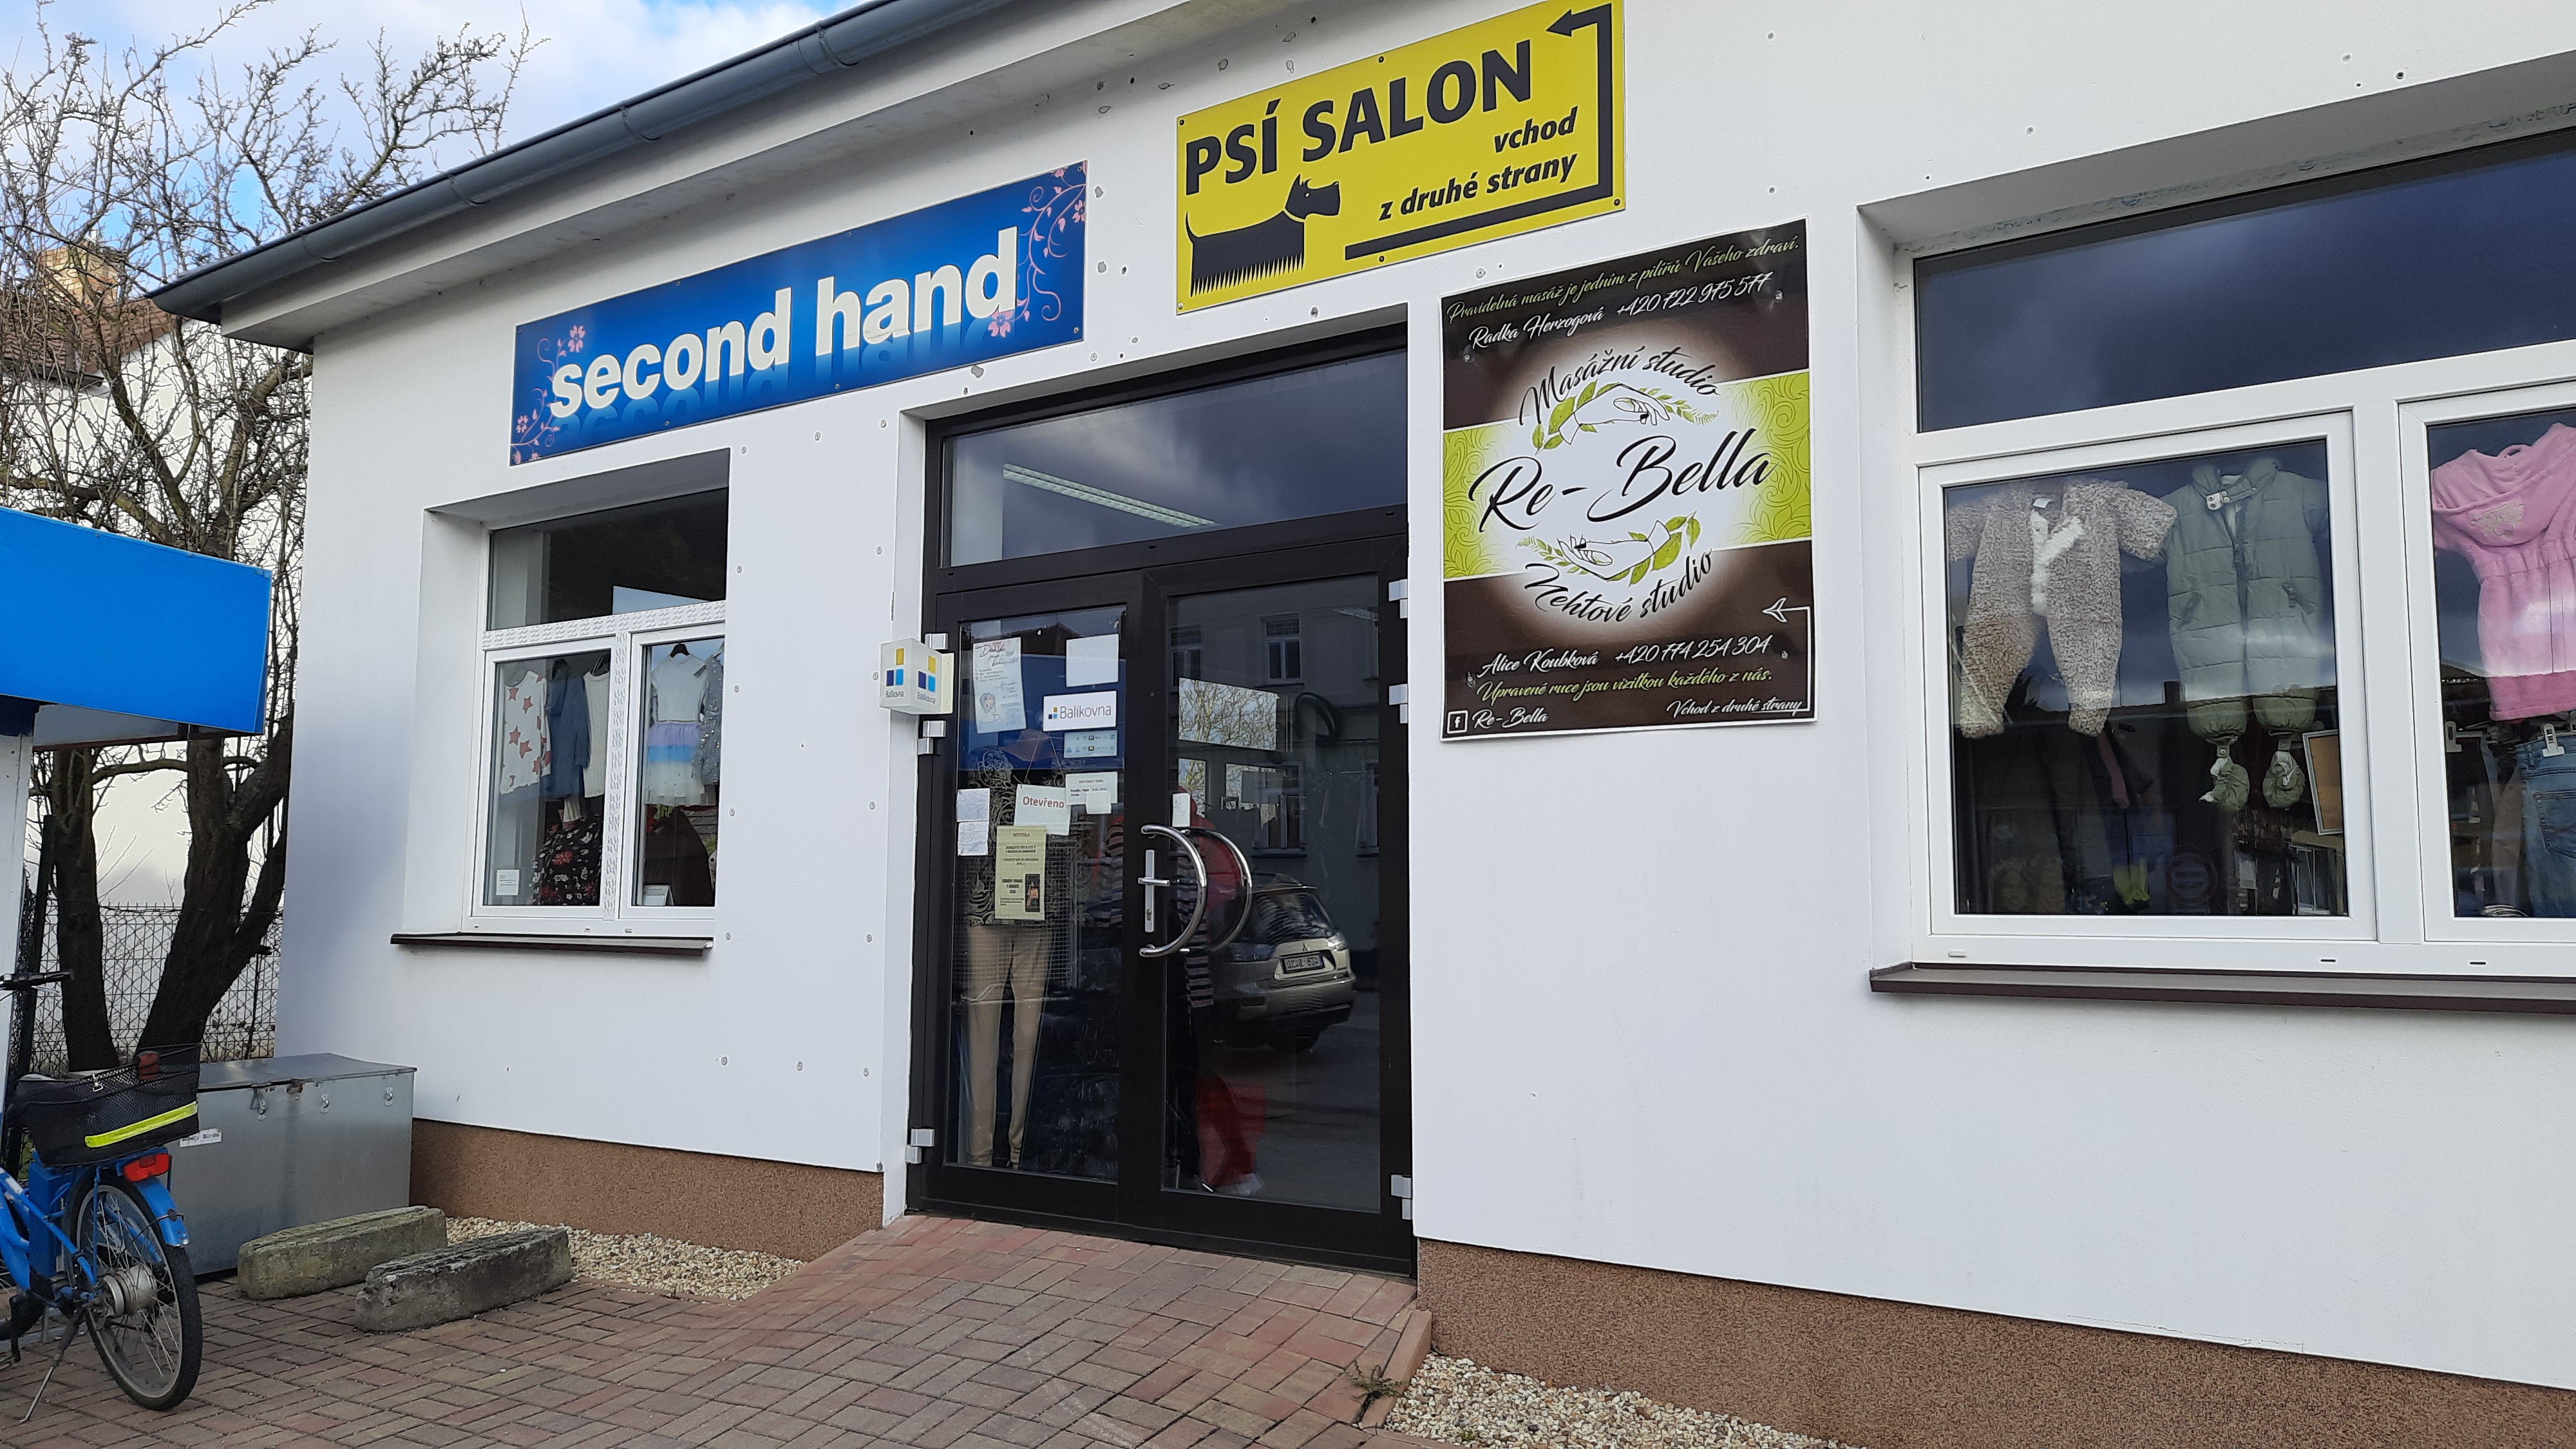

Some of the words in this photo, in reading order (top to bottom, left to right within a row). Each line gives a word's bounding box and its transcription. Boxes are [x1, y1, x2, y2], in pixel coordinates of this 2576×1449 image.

[1186, 98, 1281, 196] PSÍ
[1302, 39, 1531, 163] SALON
[1493, 105, 1578, 153] vchod
[1378, 201, 1393, 222] z
[1400, 171, 1478, 218] druhé
[1486, 153, 1578, 195] strany
[1446, 294, 1519, 324] Pravidelná
[1520, 285, 1563, 306] masáž
[1558, 283, 1578, 307] je
[1572, 272, 1625, 303] jedním
[1628, 272, 1638, 283] z
[1636, 260, 1681, 289] pilířů
[1685, 245, 1744, 272] Vašeho
[1745, 235, 1799, 258] zdraví.
[1468, 322, 1520, 350] Radka
[1523, 306, 1605, 339] Herzogová
[1616, 294, 1662, 316] +420
[1663, 287, 1698, 310] 722
[1698, 279, 1736, 303] 975
[1734, 271, 1774, 297] 577
[549, 287, 791, 419] second
[815, 225, 1018, 356] hand
[1519, 345, 1646, 426] Masážní
[1642, 346, 1721, 396] studio
[1524, 562, 1634, 623] Nehtové
[1640, 548, 1712, 618] studio
[1476, 680, 1547, 706] Upravené
[1548, 685, 1580, 695] ruce
[1573, 680, 1610, 701] jsou
[1612, 672, 1665, 691] vizitkou
[1667, 667, 1727, 688] každého
[1728, 672, 1739, 682] z
[1742, 667, 1772, 682] nás.
[1477, 652, 1520, 678] Alice
[1523, 648, 1600, 672] Koubková
[1615, 645, 1660, 664] +420
[1661, 640, 1695, 661] 774
[1692, 637, 1733, 659] 254
[1732, 634, 1774, 656] 304
[1060, 705, 1112, 719] Balíkovna
[1665, 698, 1711, 719] Vchod
[1710, 703, 1718, 713] z
[1721, 699, 1760, 714] druhé
[1761, 697, 1803, 717] strany
[1023, 796, 1065, 809] Otevřeno
